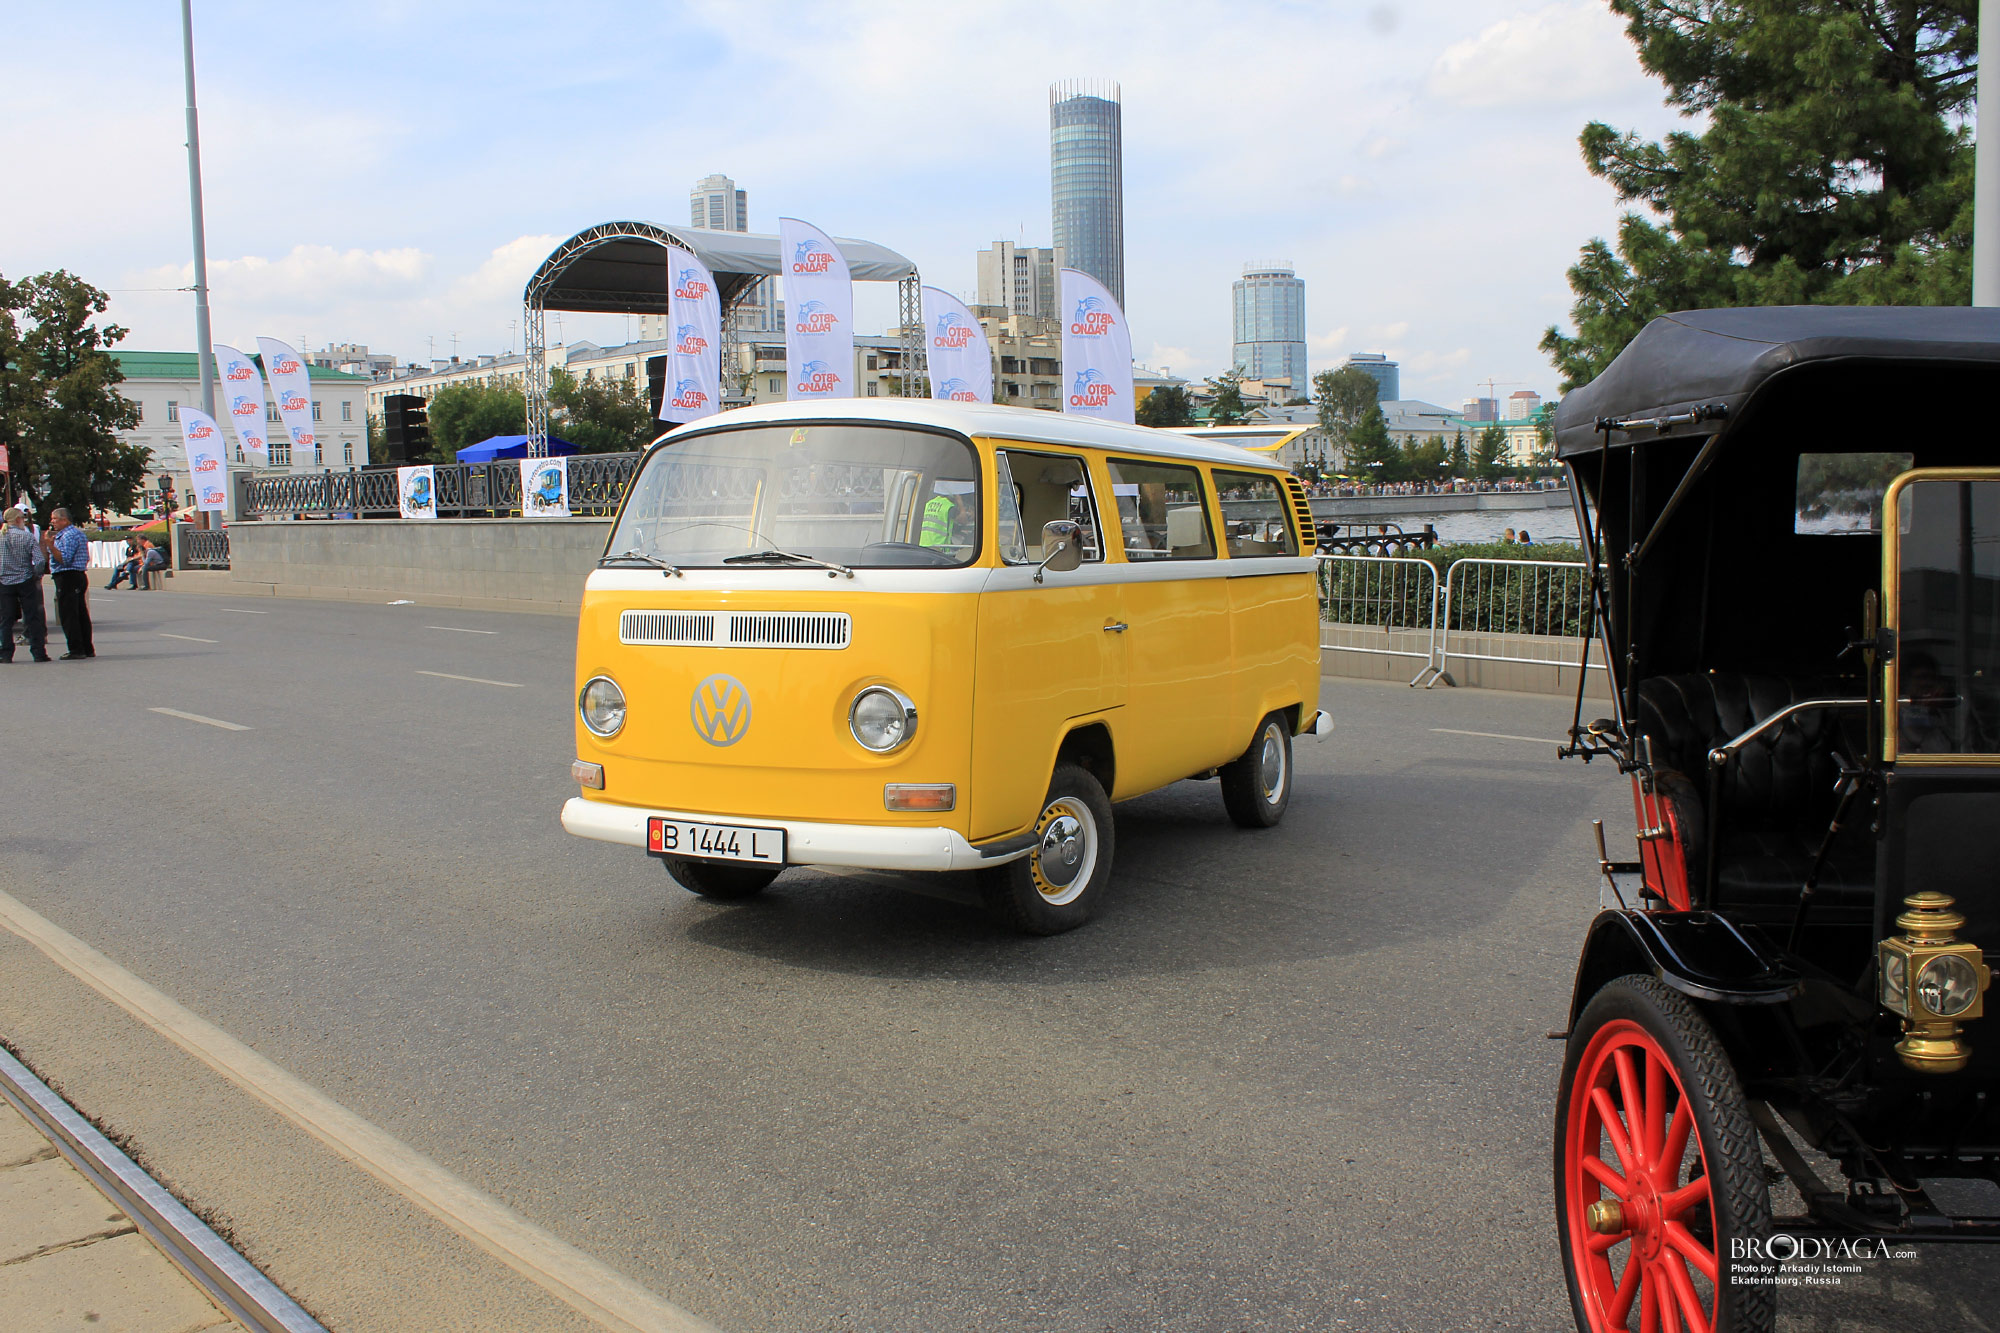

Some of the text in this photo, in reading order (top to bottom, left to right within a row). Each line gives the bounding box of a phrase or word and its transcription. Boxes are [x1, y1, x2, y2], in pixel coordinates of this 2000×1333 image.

[664, 824, 769, 858] B 1444 L
